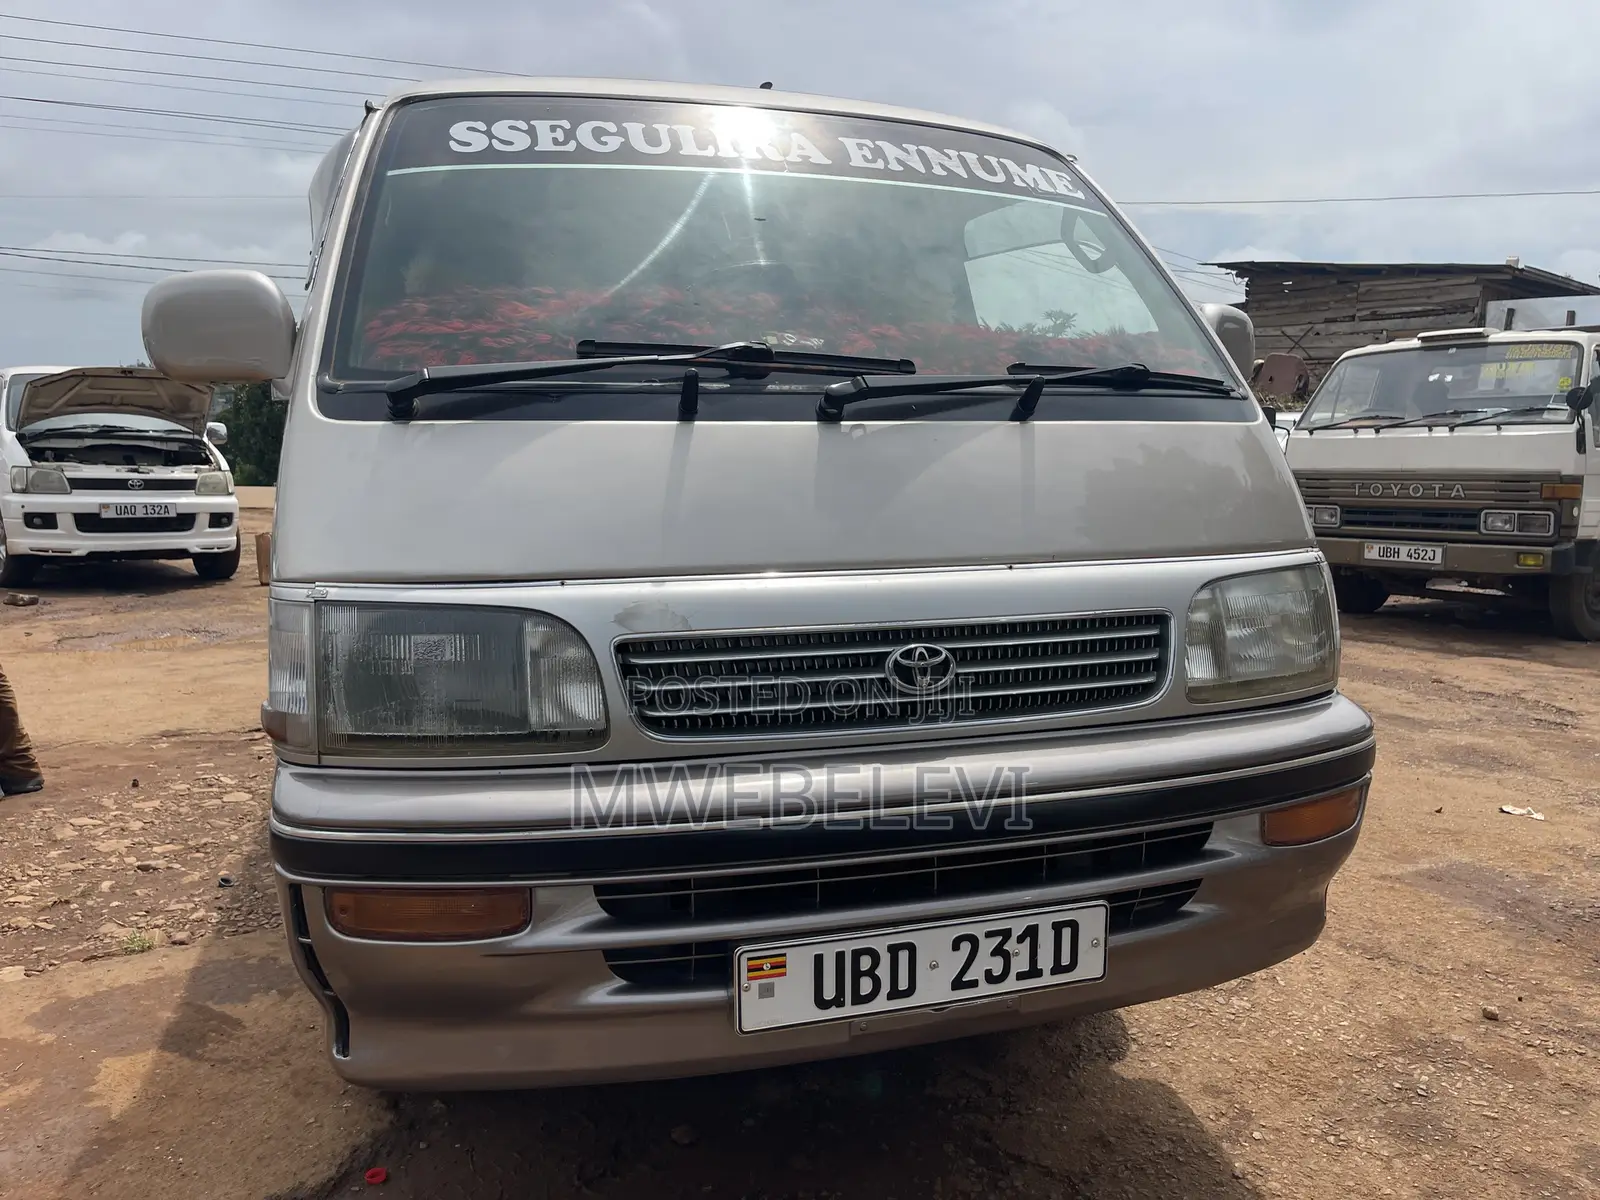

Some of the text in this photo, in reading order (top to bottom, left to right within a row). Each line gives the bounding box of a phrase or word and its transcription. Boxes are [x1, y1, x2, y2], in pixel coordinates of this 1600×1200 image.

[838, 137, 1085, 200] ENNUME
[1353, 483, 1465, 498] TOYOTA
[115, 504, 170, 516] UAQ 132A
[1378, 546, 1436, 561] UBH 452J
[813, 919, 1080, 1010] UBD 231D
